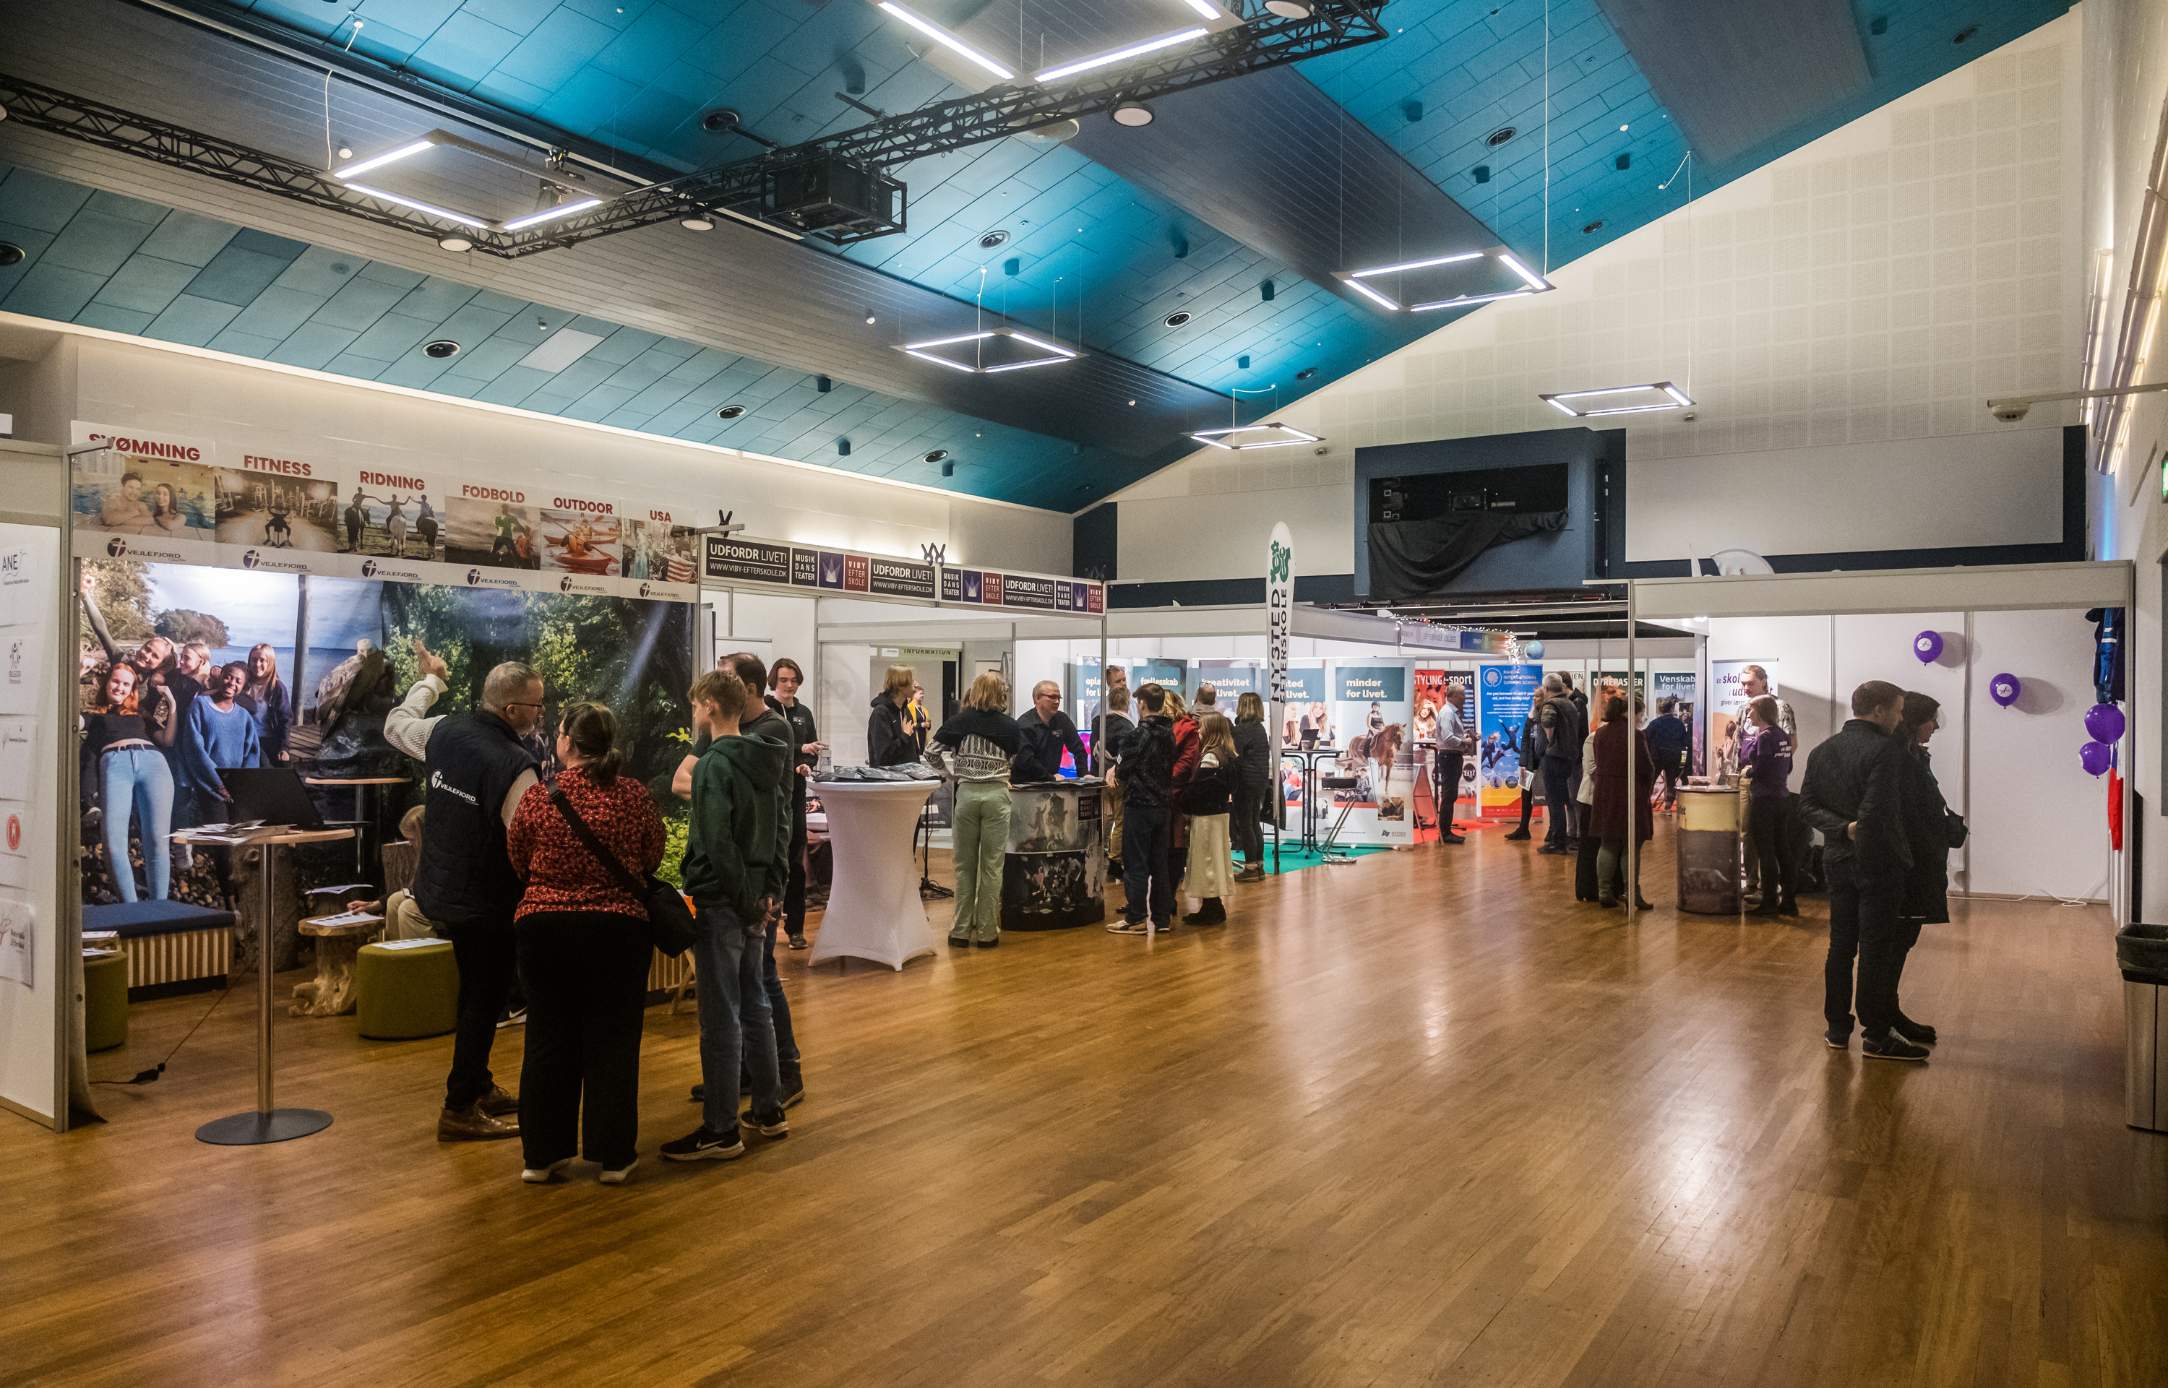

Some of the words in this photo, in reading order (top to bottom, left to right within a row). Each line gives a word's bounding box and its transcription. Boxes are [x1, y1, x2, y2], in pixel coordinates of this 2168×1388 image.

[244, 455, 312, 476] FITNESS
[360, 471, 425, 491] RIDNING
[462, 484, 525, 503] FODBOLD
[553, 497, 613, 515] OUTDOOR
[650, 509, 672, 523] USA
[710, 543, 759, 560] UDFORDR
[761, 549, 787, 564] LIVET!
[795, 554, 815, 563] MUSIK
[795, 563, 815, 572] DANS
[848, 560, 866, 569] VIBY
[709, 562, 787, 577] WWW.VIBY-EFTERSKOLE.DK
[848, 569, 865, 578] EFTER
[873, 564, 911, 578] UDFORDR
[912, 569, 933, 581] LIVET!
[795, 572, 815, 581] TEATER
[943, 572, 960, 580] MUSIK
[848, 578, 865, 586] SKOLE
[943, 580, 960, 588] DANS
[1005, 579, 1036, 591] UDFORDR
[1037, 583, 1053, 593] LIVET!
[943, 588, 960, 596] TEATER
[1271, 588, 1280, 702] NYSTED
[1346, 678, 1382, 687] minder
[1593, 677, 1643, 687] DREPASER
[1659, 675, 1696, 683] Venskab
[1345, 689, 1362, 698] for
[1362, 689, 1388, 698] livet.
[441, 783, 476, 802] VEJLEFJORD
